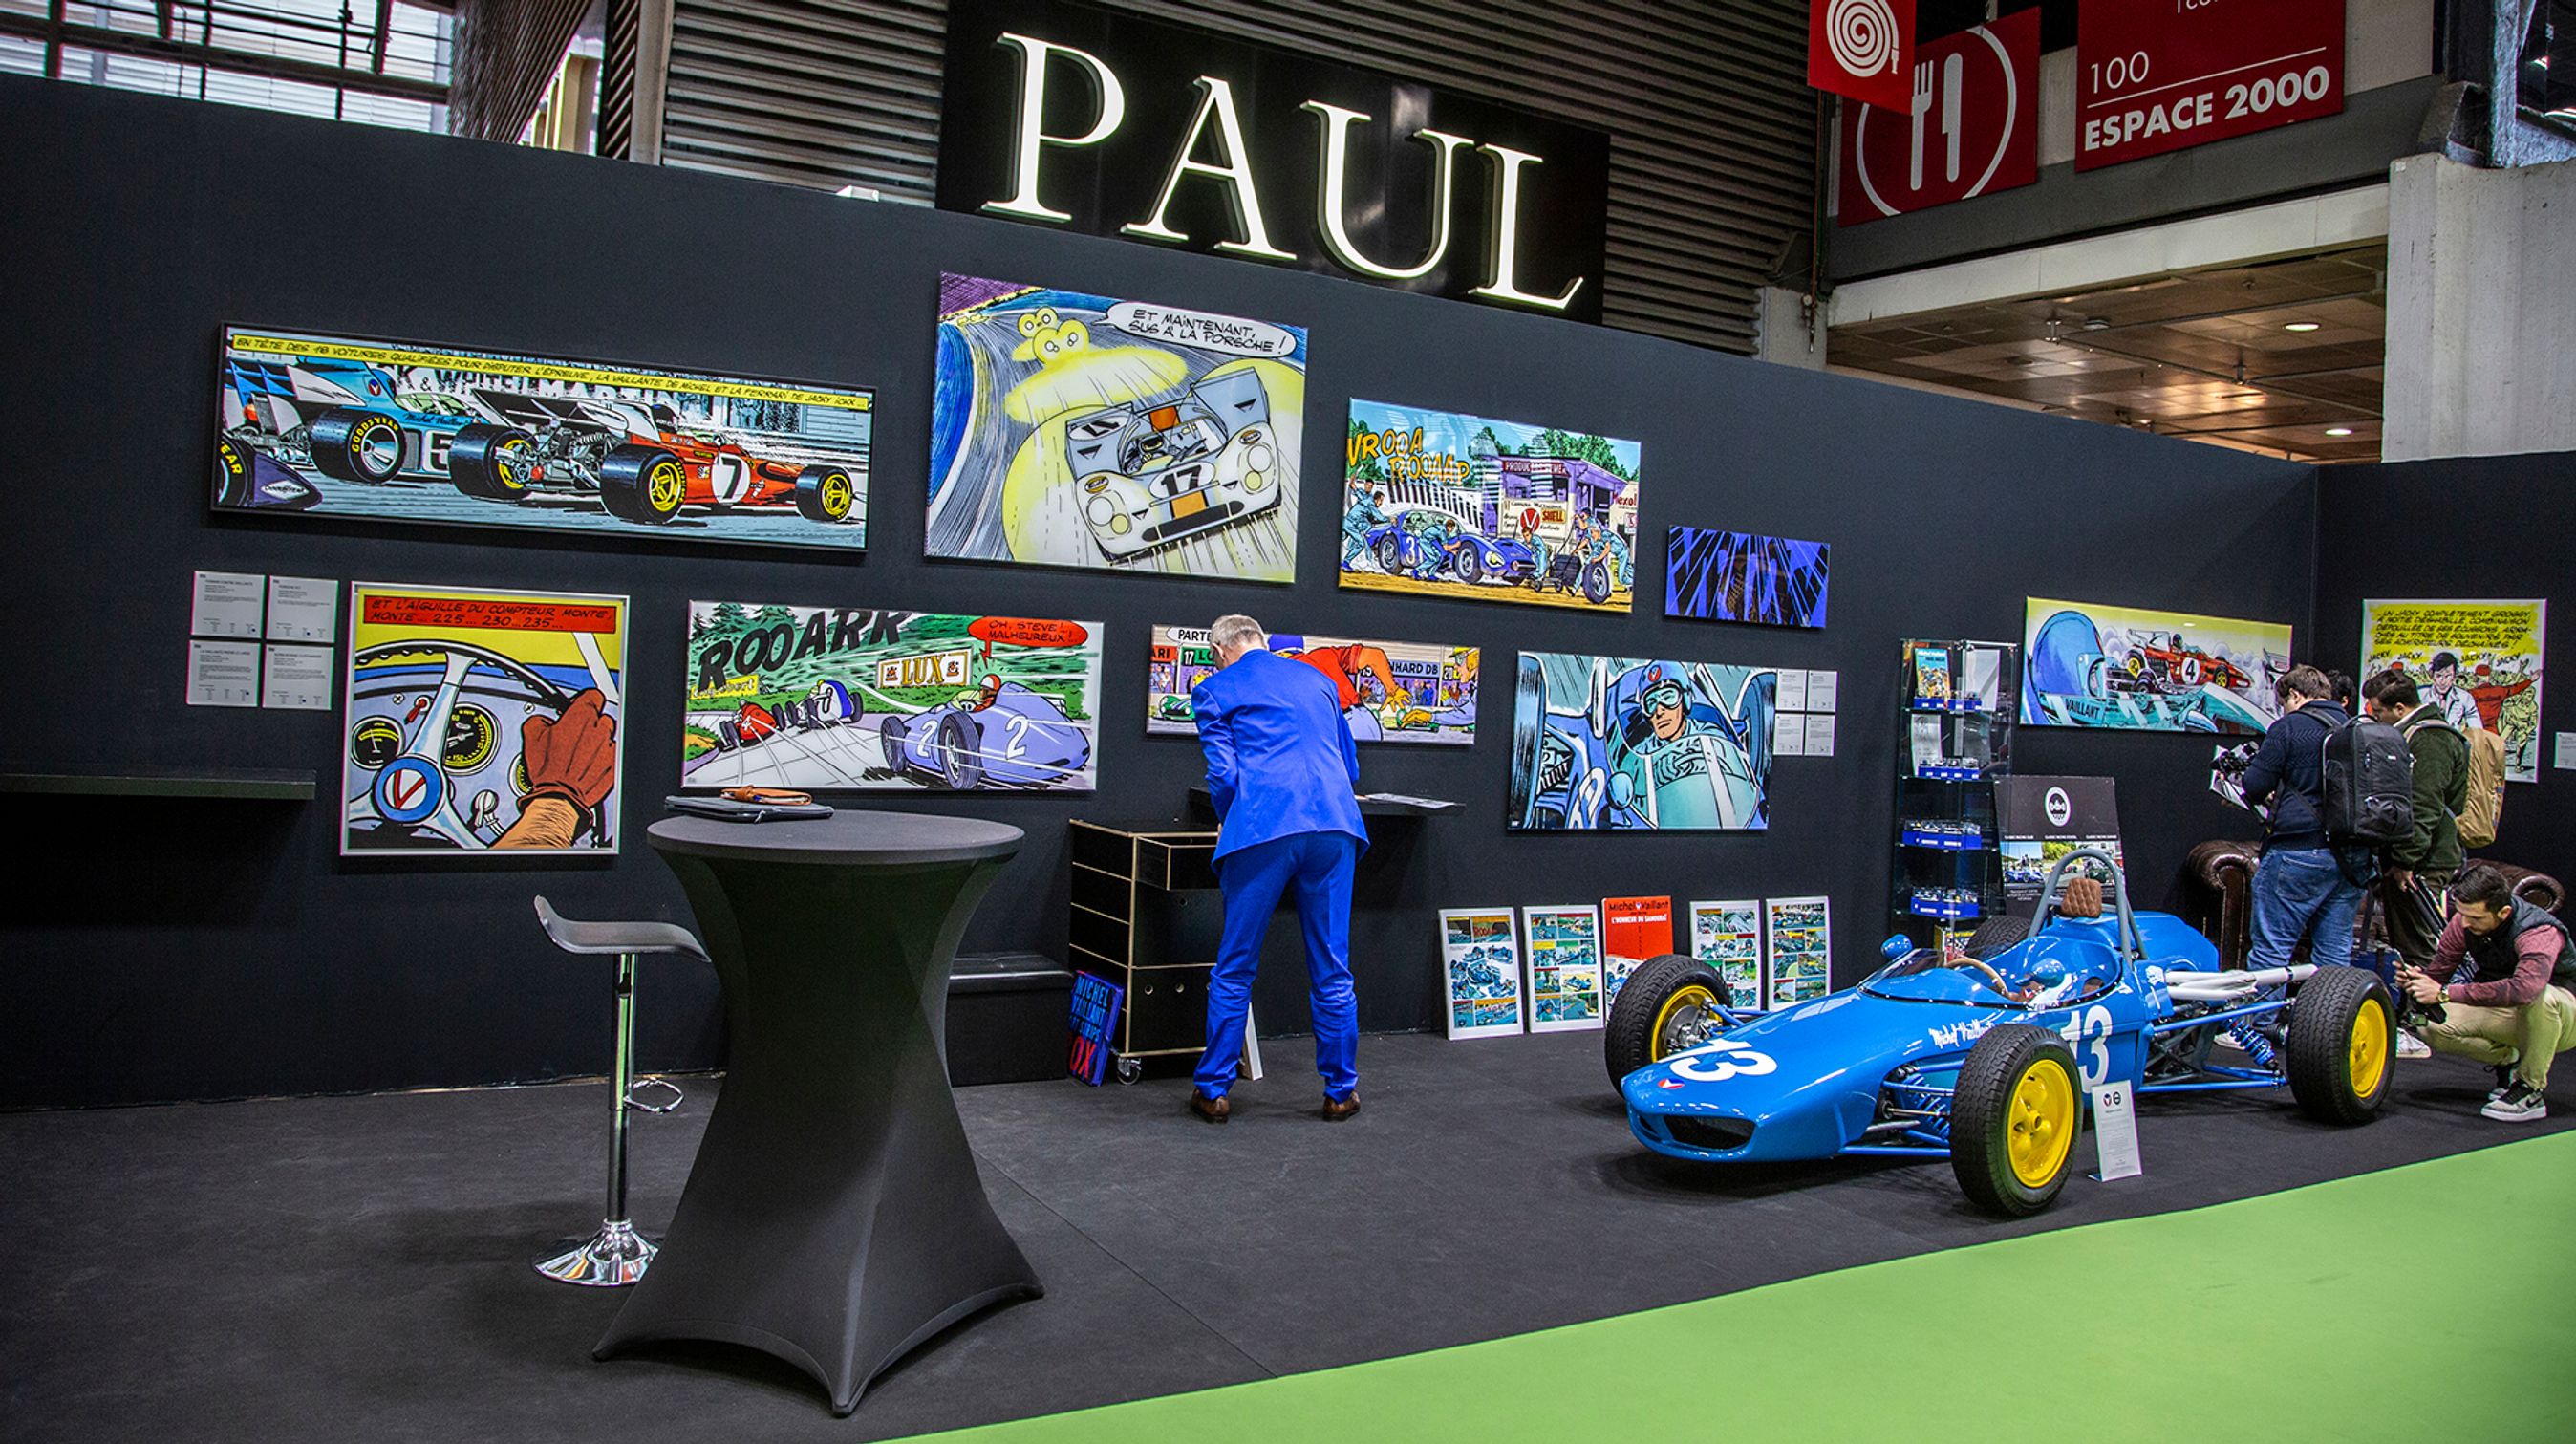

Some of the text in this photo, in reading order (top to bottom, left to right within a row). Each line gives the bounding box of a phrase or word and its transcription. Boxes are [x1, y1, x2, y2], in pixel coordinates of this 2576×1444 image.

[2091, 51, 2149, 94] 100
[2085, 65, 2329, 151] ESPACE 2000
[980, 31, 1583, 309] PAUL
[1133, 310, 1158, 321] ET
[1128, 321, 1159, 334] SUS
[1180, 329, 1197, 340] LA
[1203, 331, 1274, 352] PORSCHE
[352, 417, 398, 452] GOODYEAR
[721, 457, 743, 500] 7
[1160, 465, 1201, 498] 17
[1542, 509, 1564, 523] SHELL
[396, 600, 462, 612] L'AIGUILLE
[466, 604, 483, 613] DU
[488, 606, 555, 616] COMPTEUR
[988, 631, 1064, 642] MALHEUREUX
[989, 622, 1012, 633] OH,
[1017, 622, 1057, 632] STEVE
[698, 610, 913, 690] ROOARK
[1185, 651, 1194, 665] 17
[900, 654, 945, 685] LUX
[1426, 663, 1439, 675] DB
[2185, 661, 2196, 680] 4
[2064, 697, 2100, 719] VAILLANT
[917, 720, 938, 758] 2
[1004, 716, 1030, 760] 2
[1658, 1038, 1778, 1082] 13
[2060, 1005, 2114, 1093] 13
